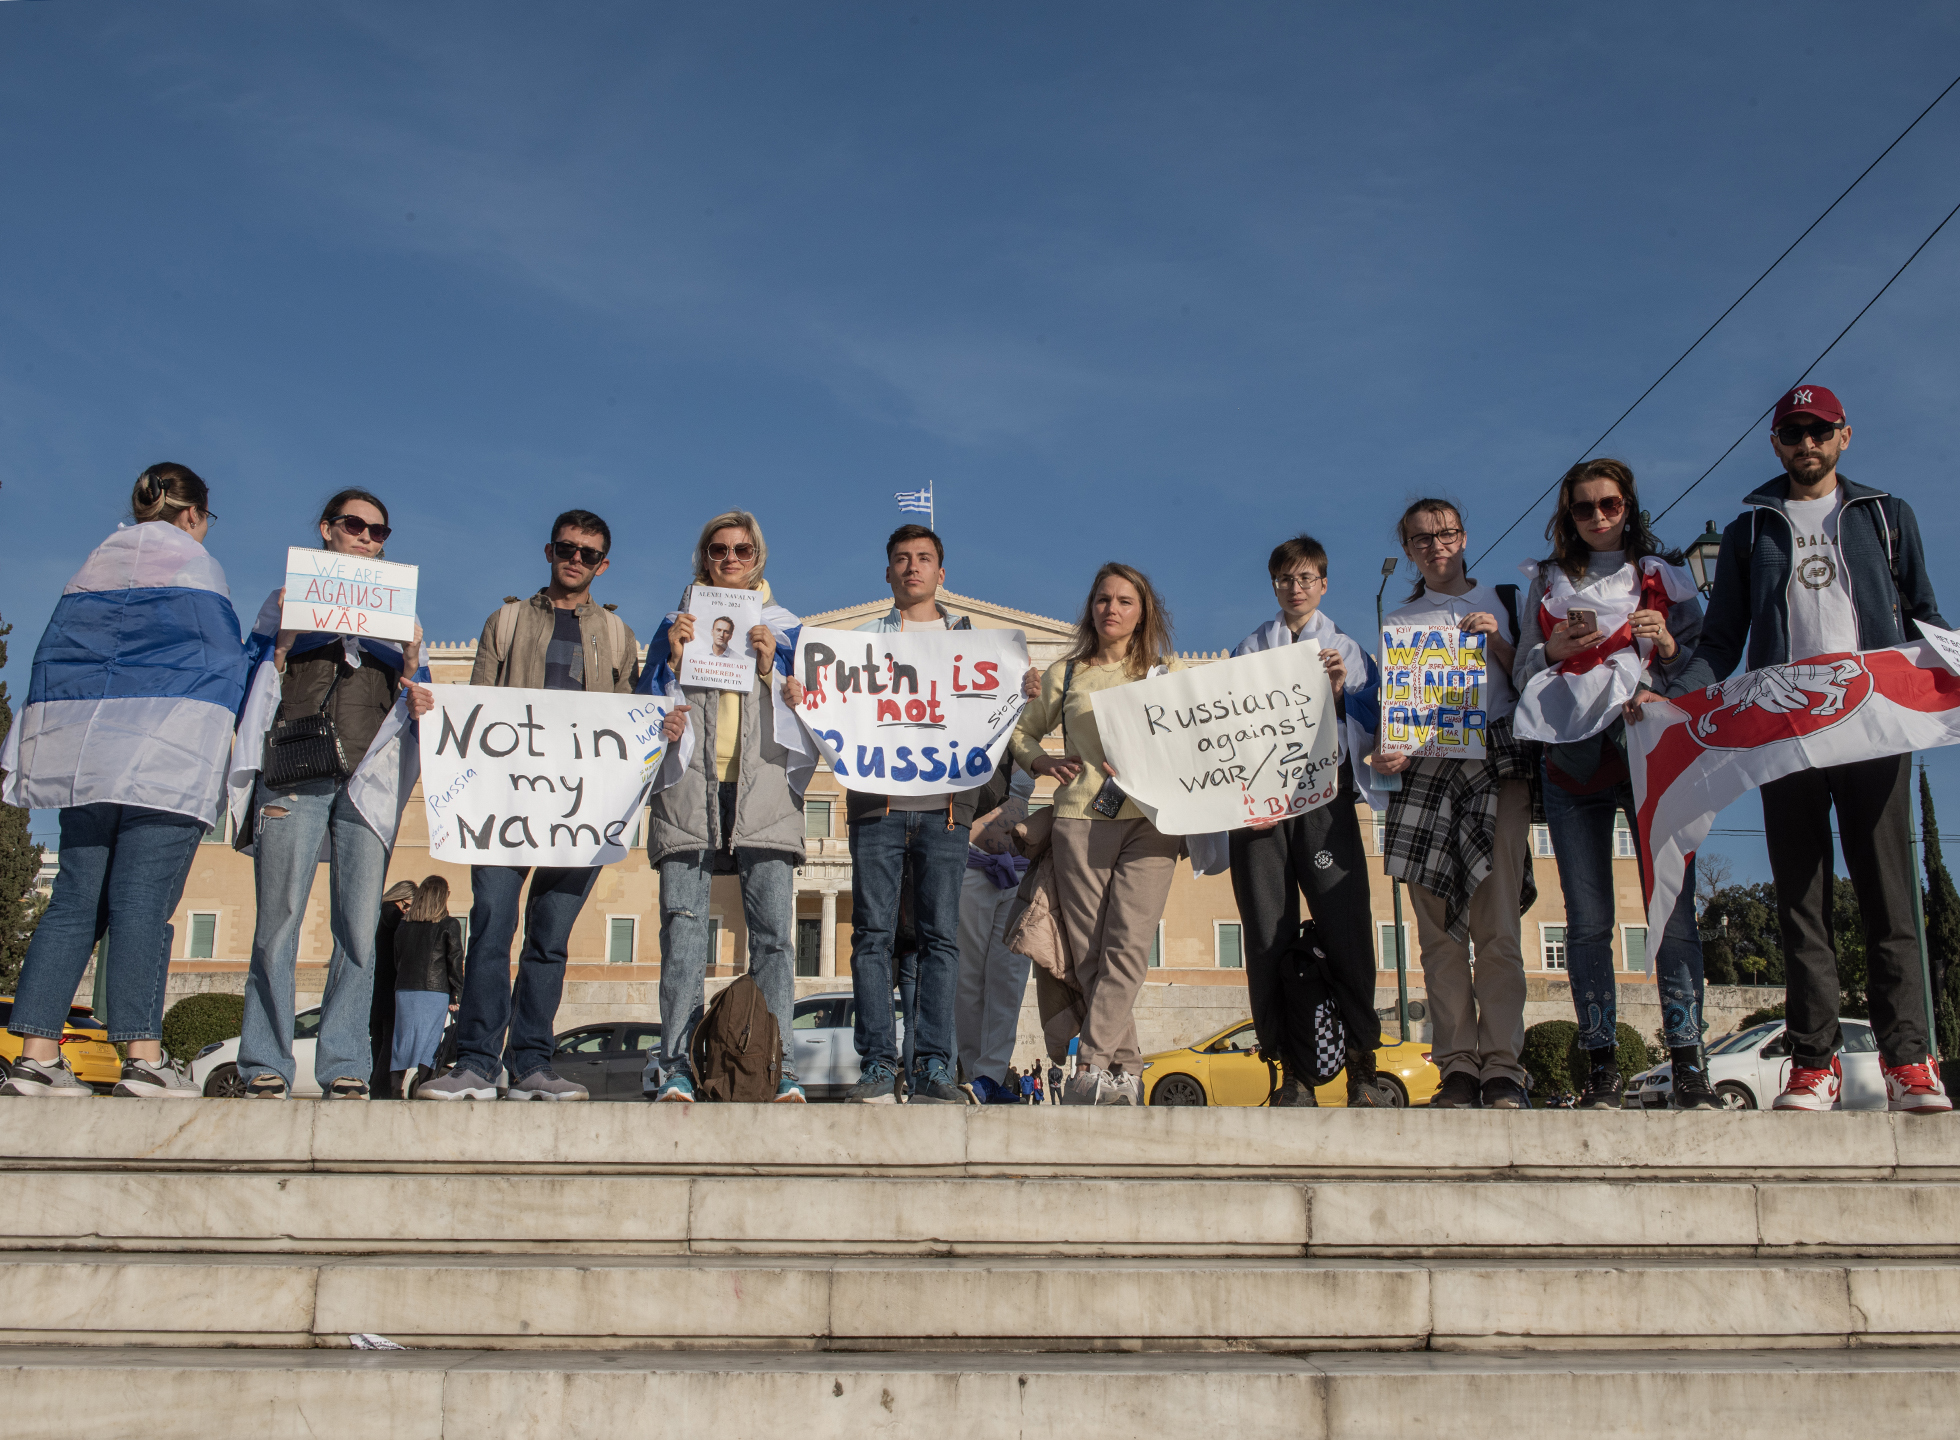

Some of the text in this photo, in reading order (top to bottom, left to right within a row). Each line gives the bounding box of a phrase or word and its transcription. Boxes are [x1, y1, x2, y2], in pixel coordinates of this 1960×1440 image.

[312, 554, 384, 585] WE ARE
[304, 578, 400, 612] AGAINST
[724, 592, 756, 601] NAVALNY
[312, 608, 370, 633] WAR
[715, 661, 748, 670] FEBRUARY
[1384, 630, 1486, 666] WAR
[691, 675, 722, 683] VLADIMIR
[694, 667, 734, 678] MURDERED
[952, 654, 1000, 693] is
[1424, 670, 1486, 706] NOT
[628, 702, 656, 723] no
[877, 680, 945, 724] not
[1144, 683, 1312, 736] Russians
[435, 703, 628, 760] Not in
[1198, 708, 1316, 763] against
[1388, 706, 1486, 747] OVER
[812, 728, 993, 782] Russia
[428, 768, 478, 818] Russia
[509, 773, 584, 819] my
[1264, 780, 1334, 816] Blood
[1297, 774, 1316, 790] of
[456, 813, 628, 850] Name
